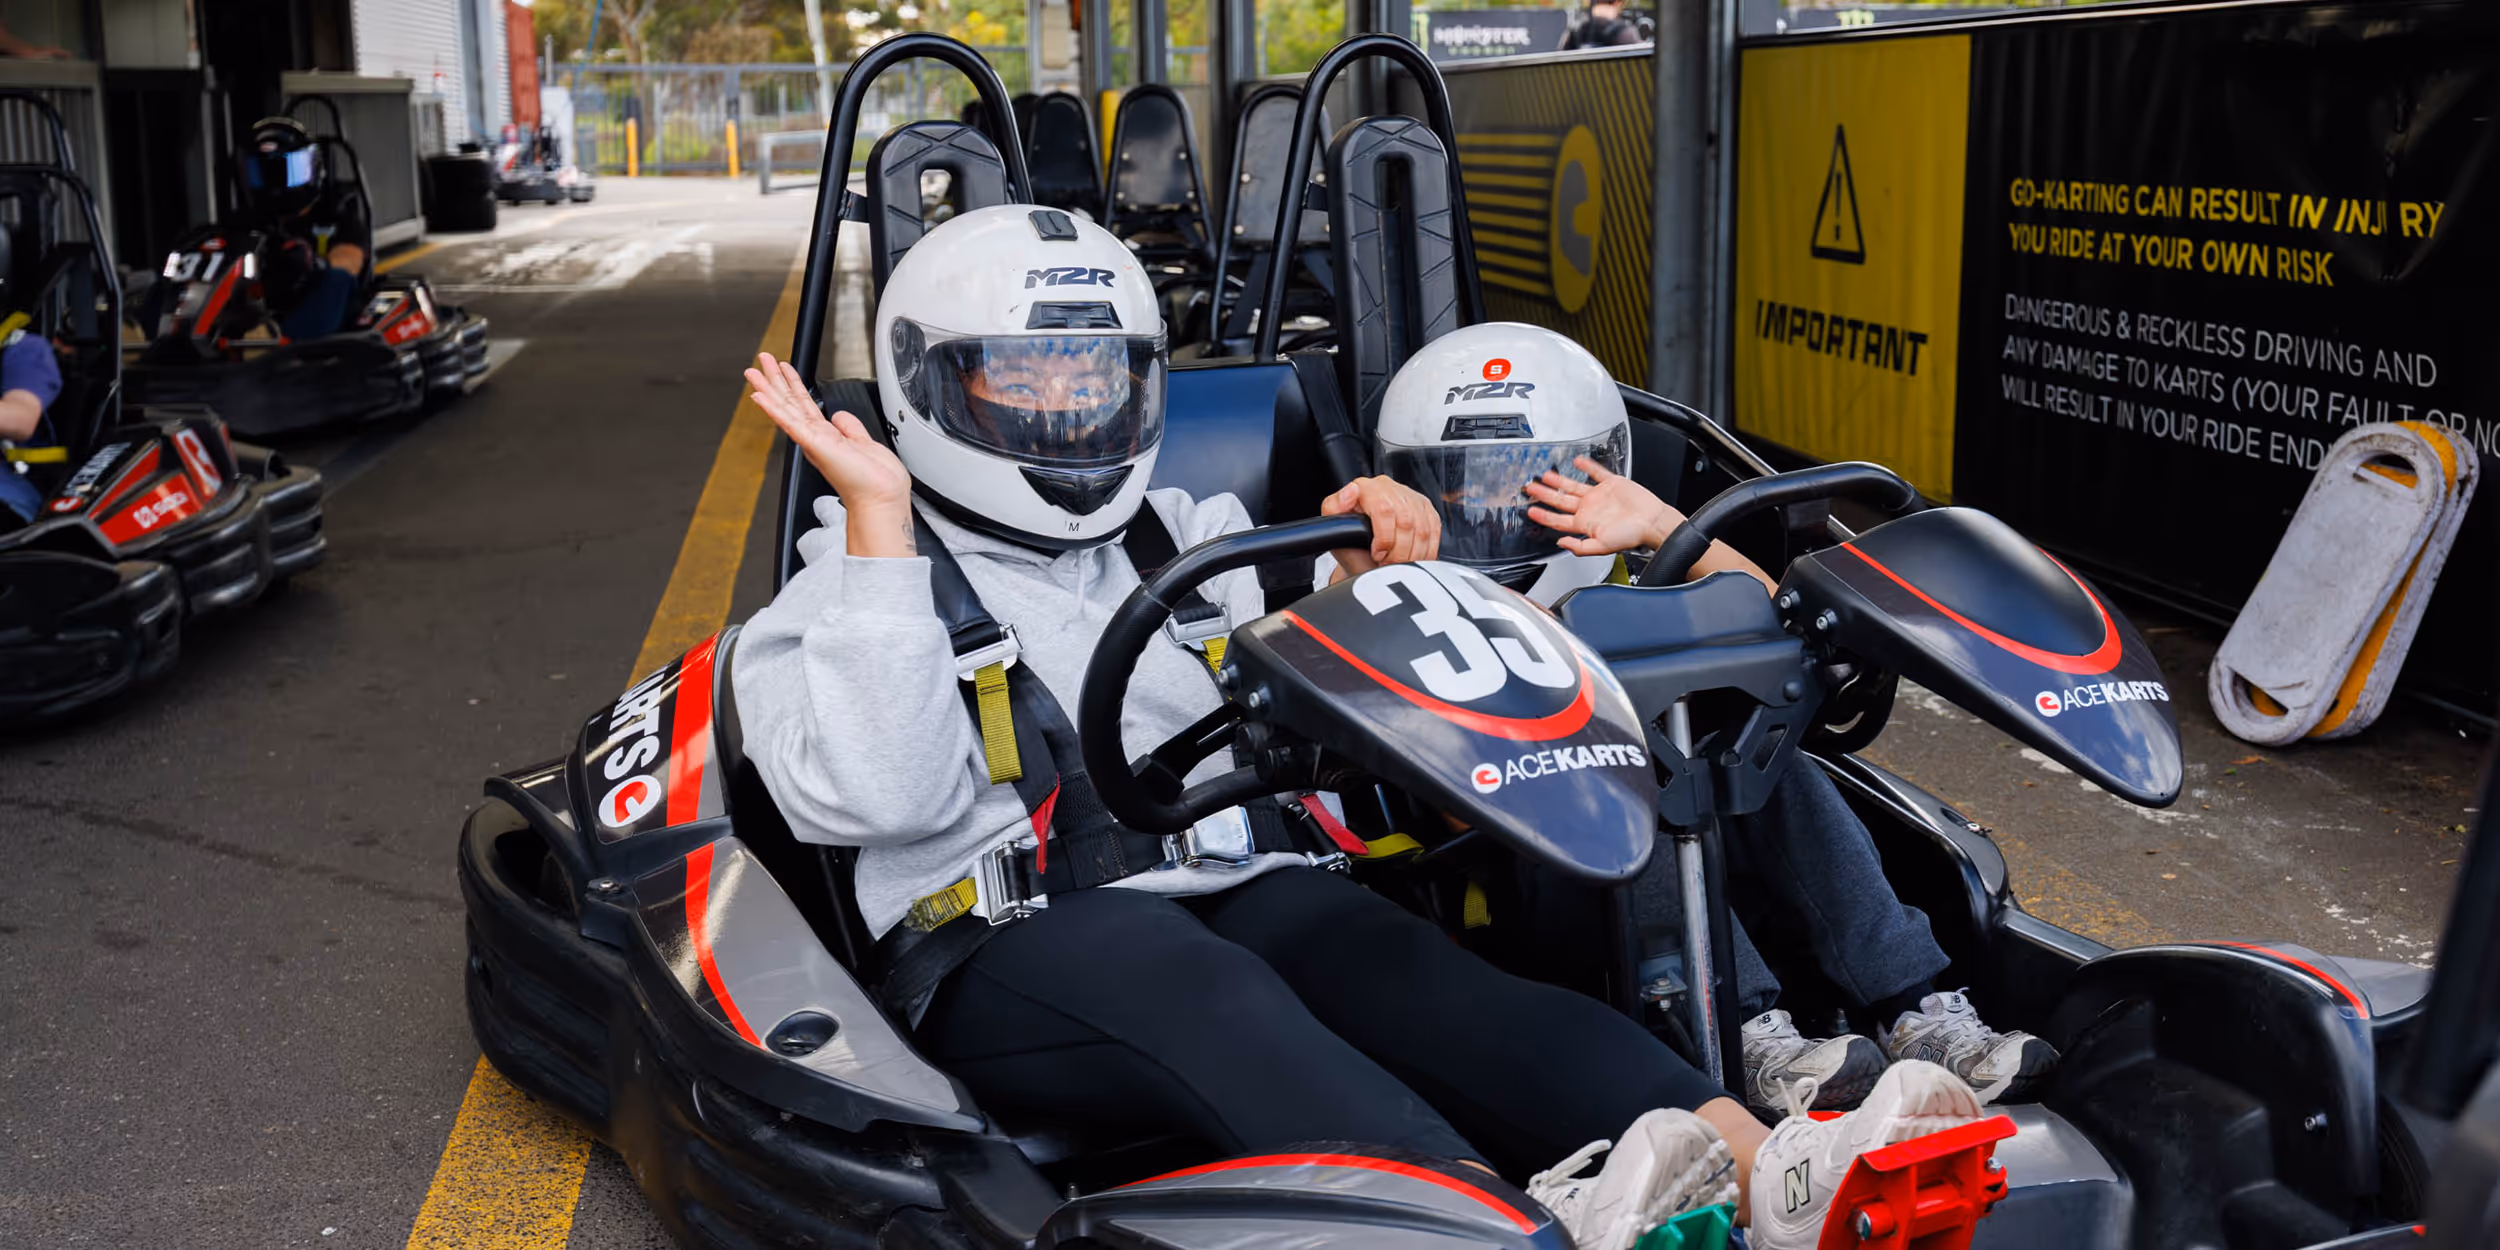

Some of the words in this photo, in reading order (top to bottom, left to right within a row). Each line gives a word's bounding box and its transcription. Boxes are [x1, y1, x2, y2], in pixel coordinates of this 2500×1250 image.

[2010, 178, 2129, 215] GO-KARTING
[2135, 184, 2183, 218] CAN
[2189, 187, 2281, 226] RESULT
[2289, 194, 2328, 230] IN
[1025, 267, 1115, 289] M2R
[2008, 222, 2046, 255] YOU
[2050, 226, 2095, 260] RIDE
[2098, 231, 2125, 263] AT
[2130, 233, 2193, 270] YOUR
[2201, 240, 2268, 278] OWN
[2276, 246, 2334, 287] RISK
[1755, 299, 1928, 377] IMPORTANT
[2004, 293, 2111, 338] DANGEROUS
[2116, 310, 2131, 340] &
[2137, 313, 2246, 359] RECKLESS
[2254, 330, 2364, 377] DRIVING
[2373, 349, 2437, 388] AND
[1444, 382, 1535, 405] M2R
[2001, 334, 2039, 366] ANY
[2041, 341, 2119, 383] DAMAGE
[2125, 355, 2149, 388] TO
[2153, 361, 2225, 404] KARTS
[2232, 376, 2320, 421] (YOUR
[2001, 374, 2041, 409] WILL
[2044, 383, 2112, 425] RESULT
[2116, 400, 2135, 431] IN
[2139, 404, 2197, 446] YOUR
[2202, 418, 2262, 459] RIDE
[1352, 561, 1575, 701] 35
[1785, 1158, 1810, 1214] N
